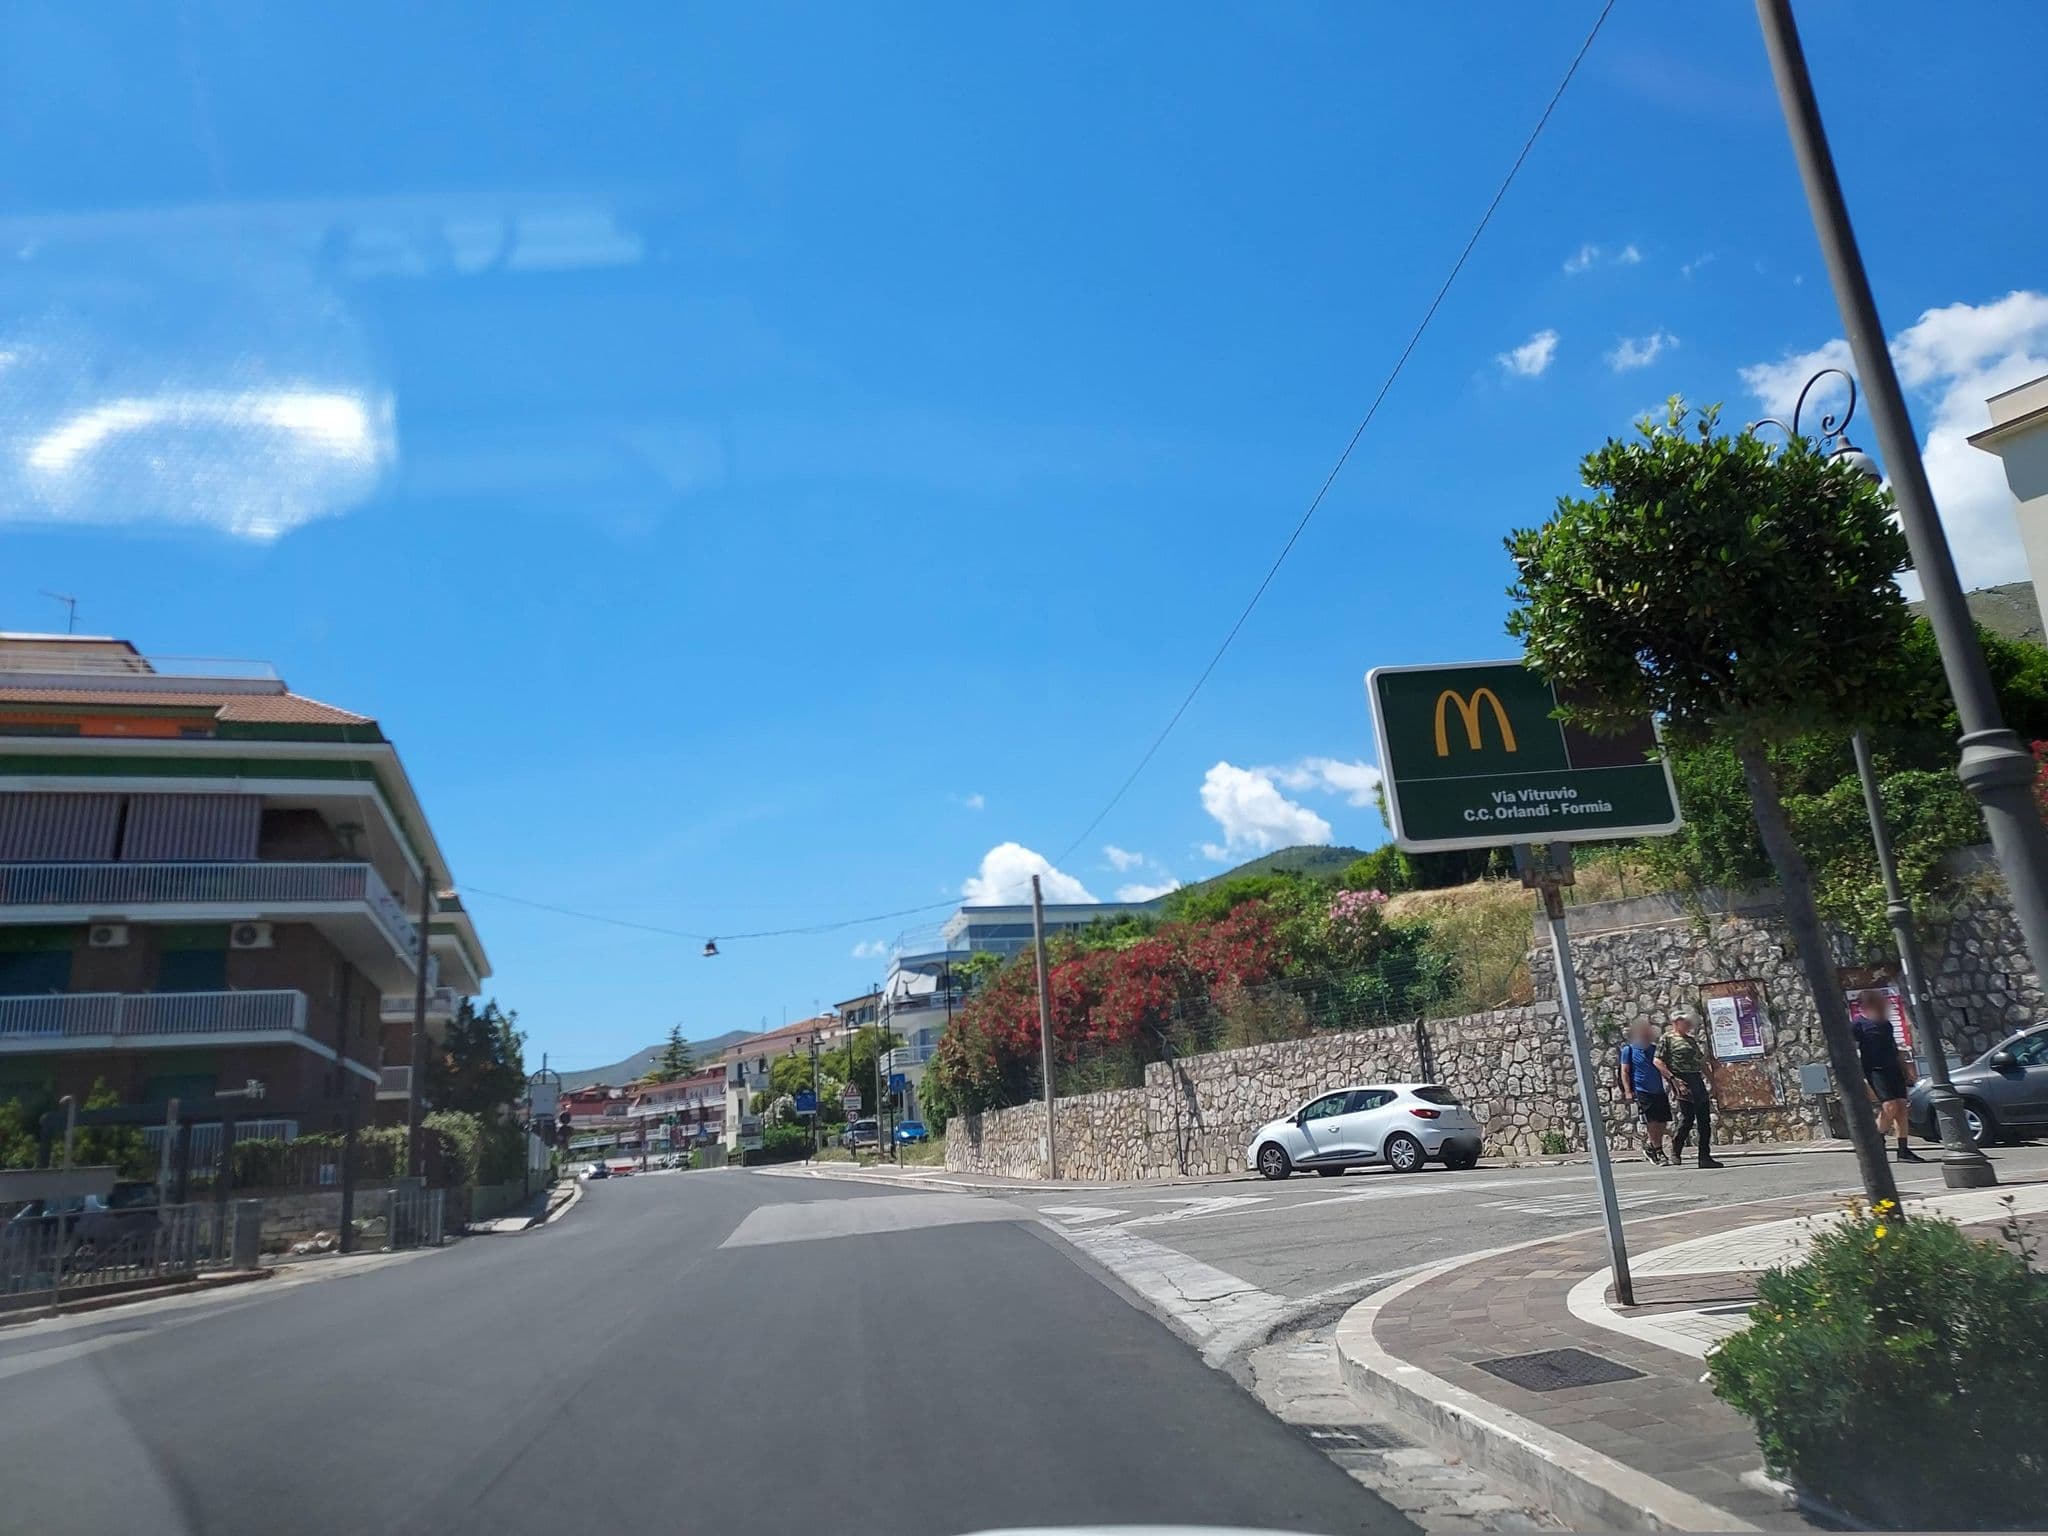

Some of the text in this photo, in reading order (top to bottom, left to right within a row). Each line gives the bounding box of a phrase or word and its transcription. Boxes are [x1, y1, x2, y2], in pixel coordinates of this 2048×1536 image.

[1435, 688, 1517, 757] M
[1491, 787, 1578, 804] Via Vitruvio
[1464, 808, 1494, 822] C.C.
[1495, 804, 1550, 819] Orlandi
[1560, 800, 1613, 815] Formia
